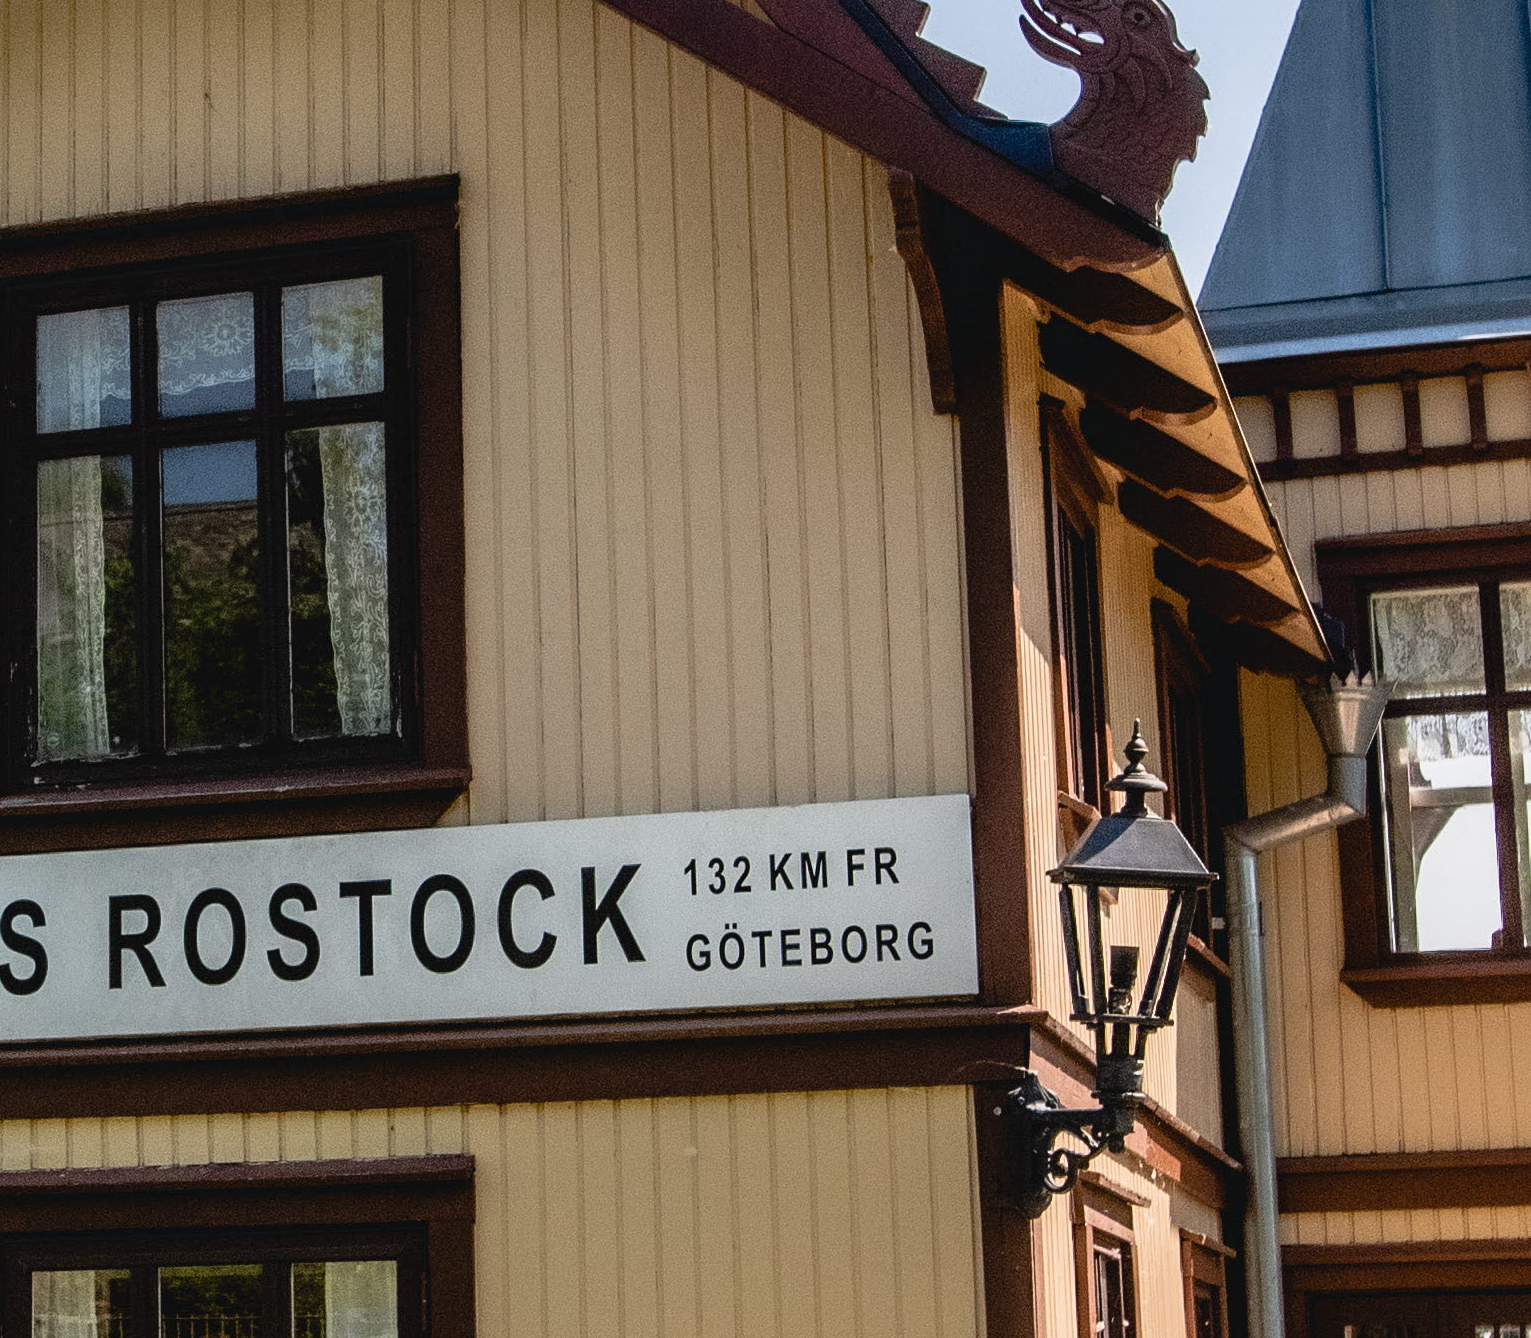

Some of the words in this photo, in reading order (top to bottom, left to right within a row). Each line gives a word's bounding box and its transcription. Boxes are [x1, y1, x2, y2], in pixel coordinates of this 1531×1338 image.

[683, 856, 752, 896] 132
[769, 850, 828, 891] KM
[846, 846, 900, 886] FR
[108, 863, 647, 989] ROSTOCK
[685, 921, 935, 972] GÖTEBORG
